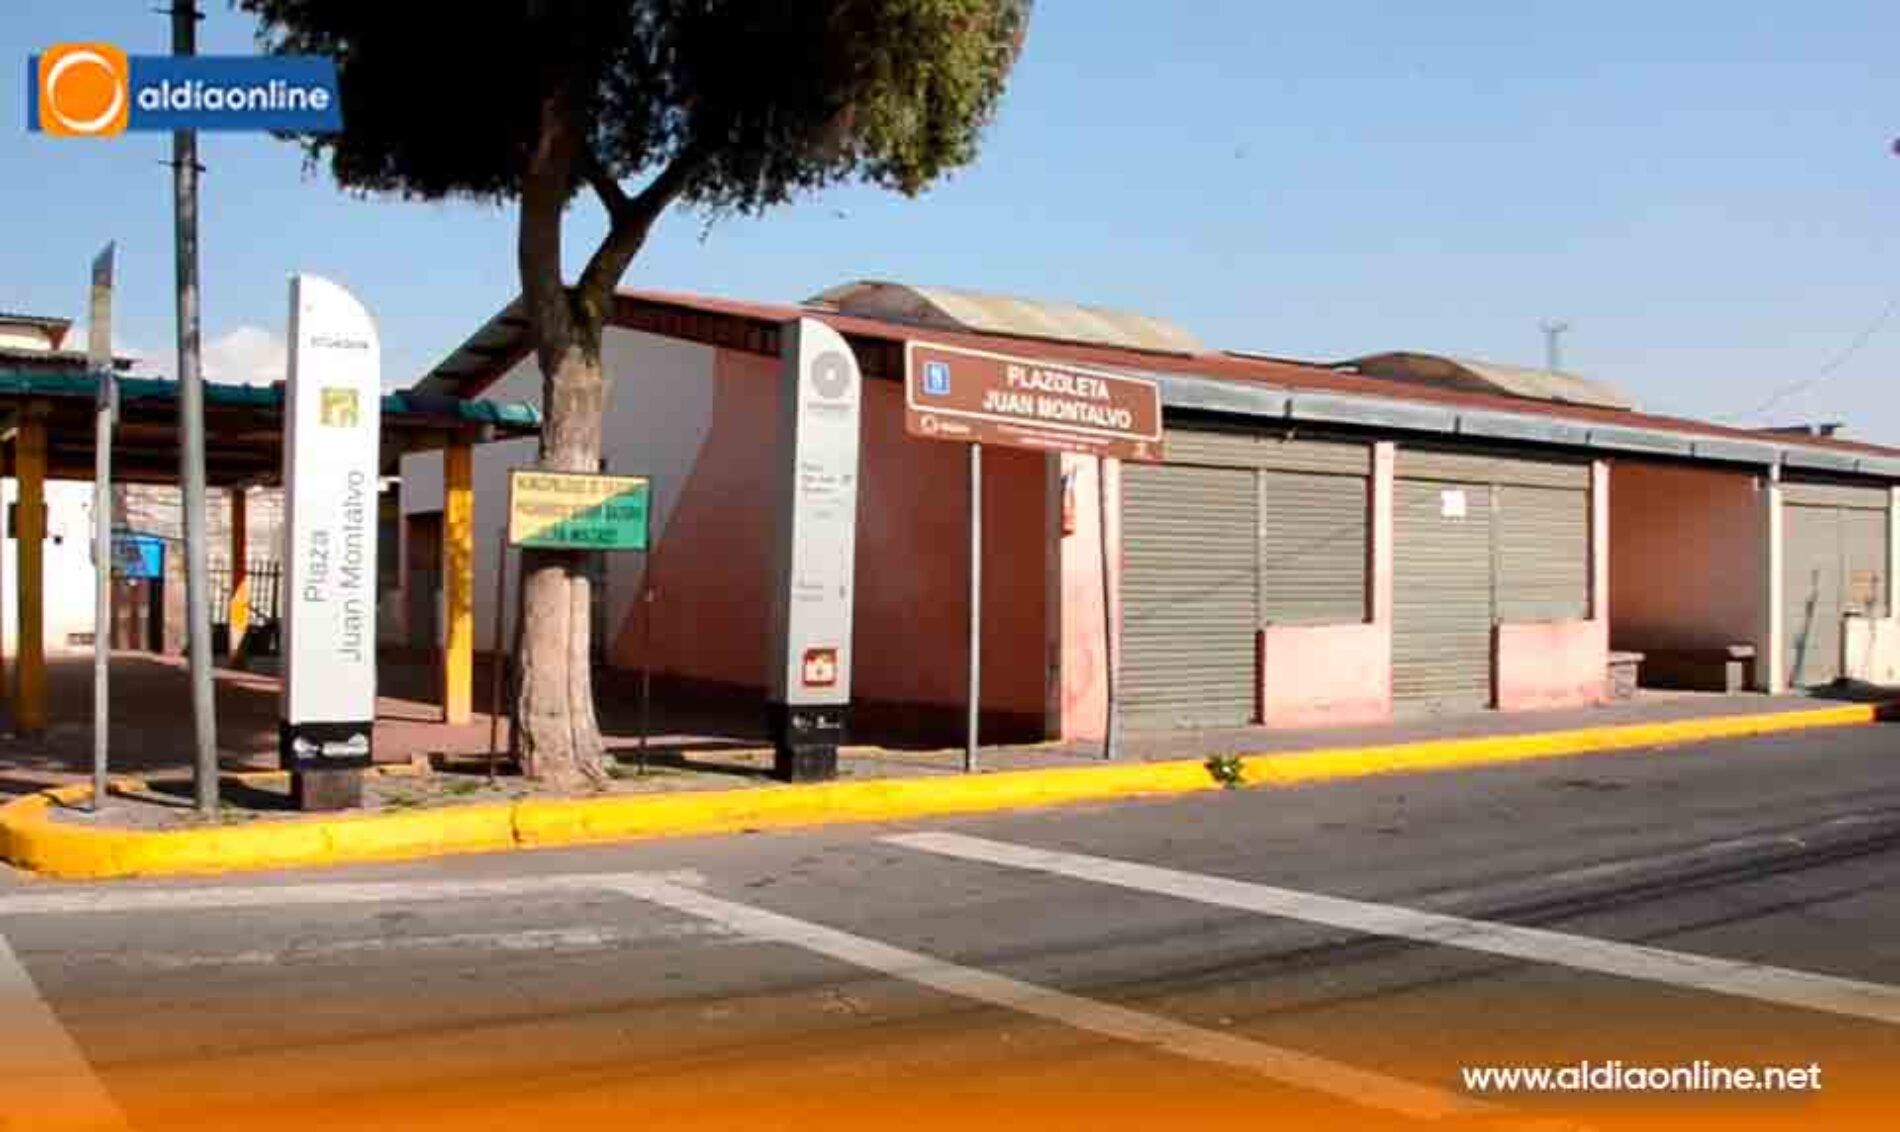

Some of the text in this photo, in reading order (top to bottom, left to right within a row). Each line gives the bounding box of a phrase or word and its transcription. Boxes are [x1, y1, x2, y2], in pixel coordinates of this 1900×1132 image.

[983, 390, 1132, 429] JUAN MONTALVO
[1006, 364, 1110, 401] PLAZOLETA
[303, 530, 328, 602] Plaza
[337, 470, 366, 663] Juan Montalvo
